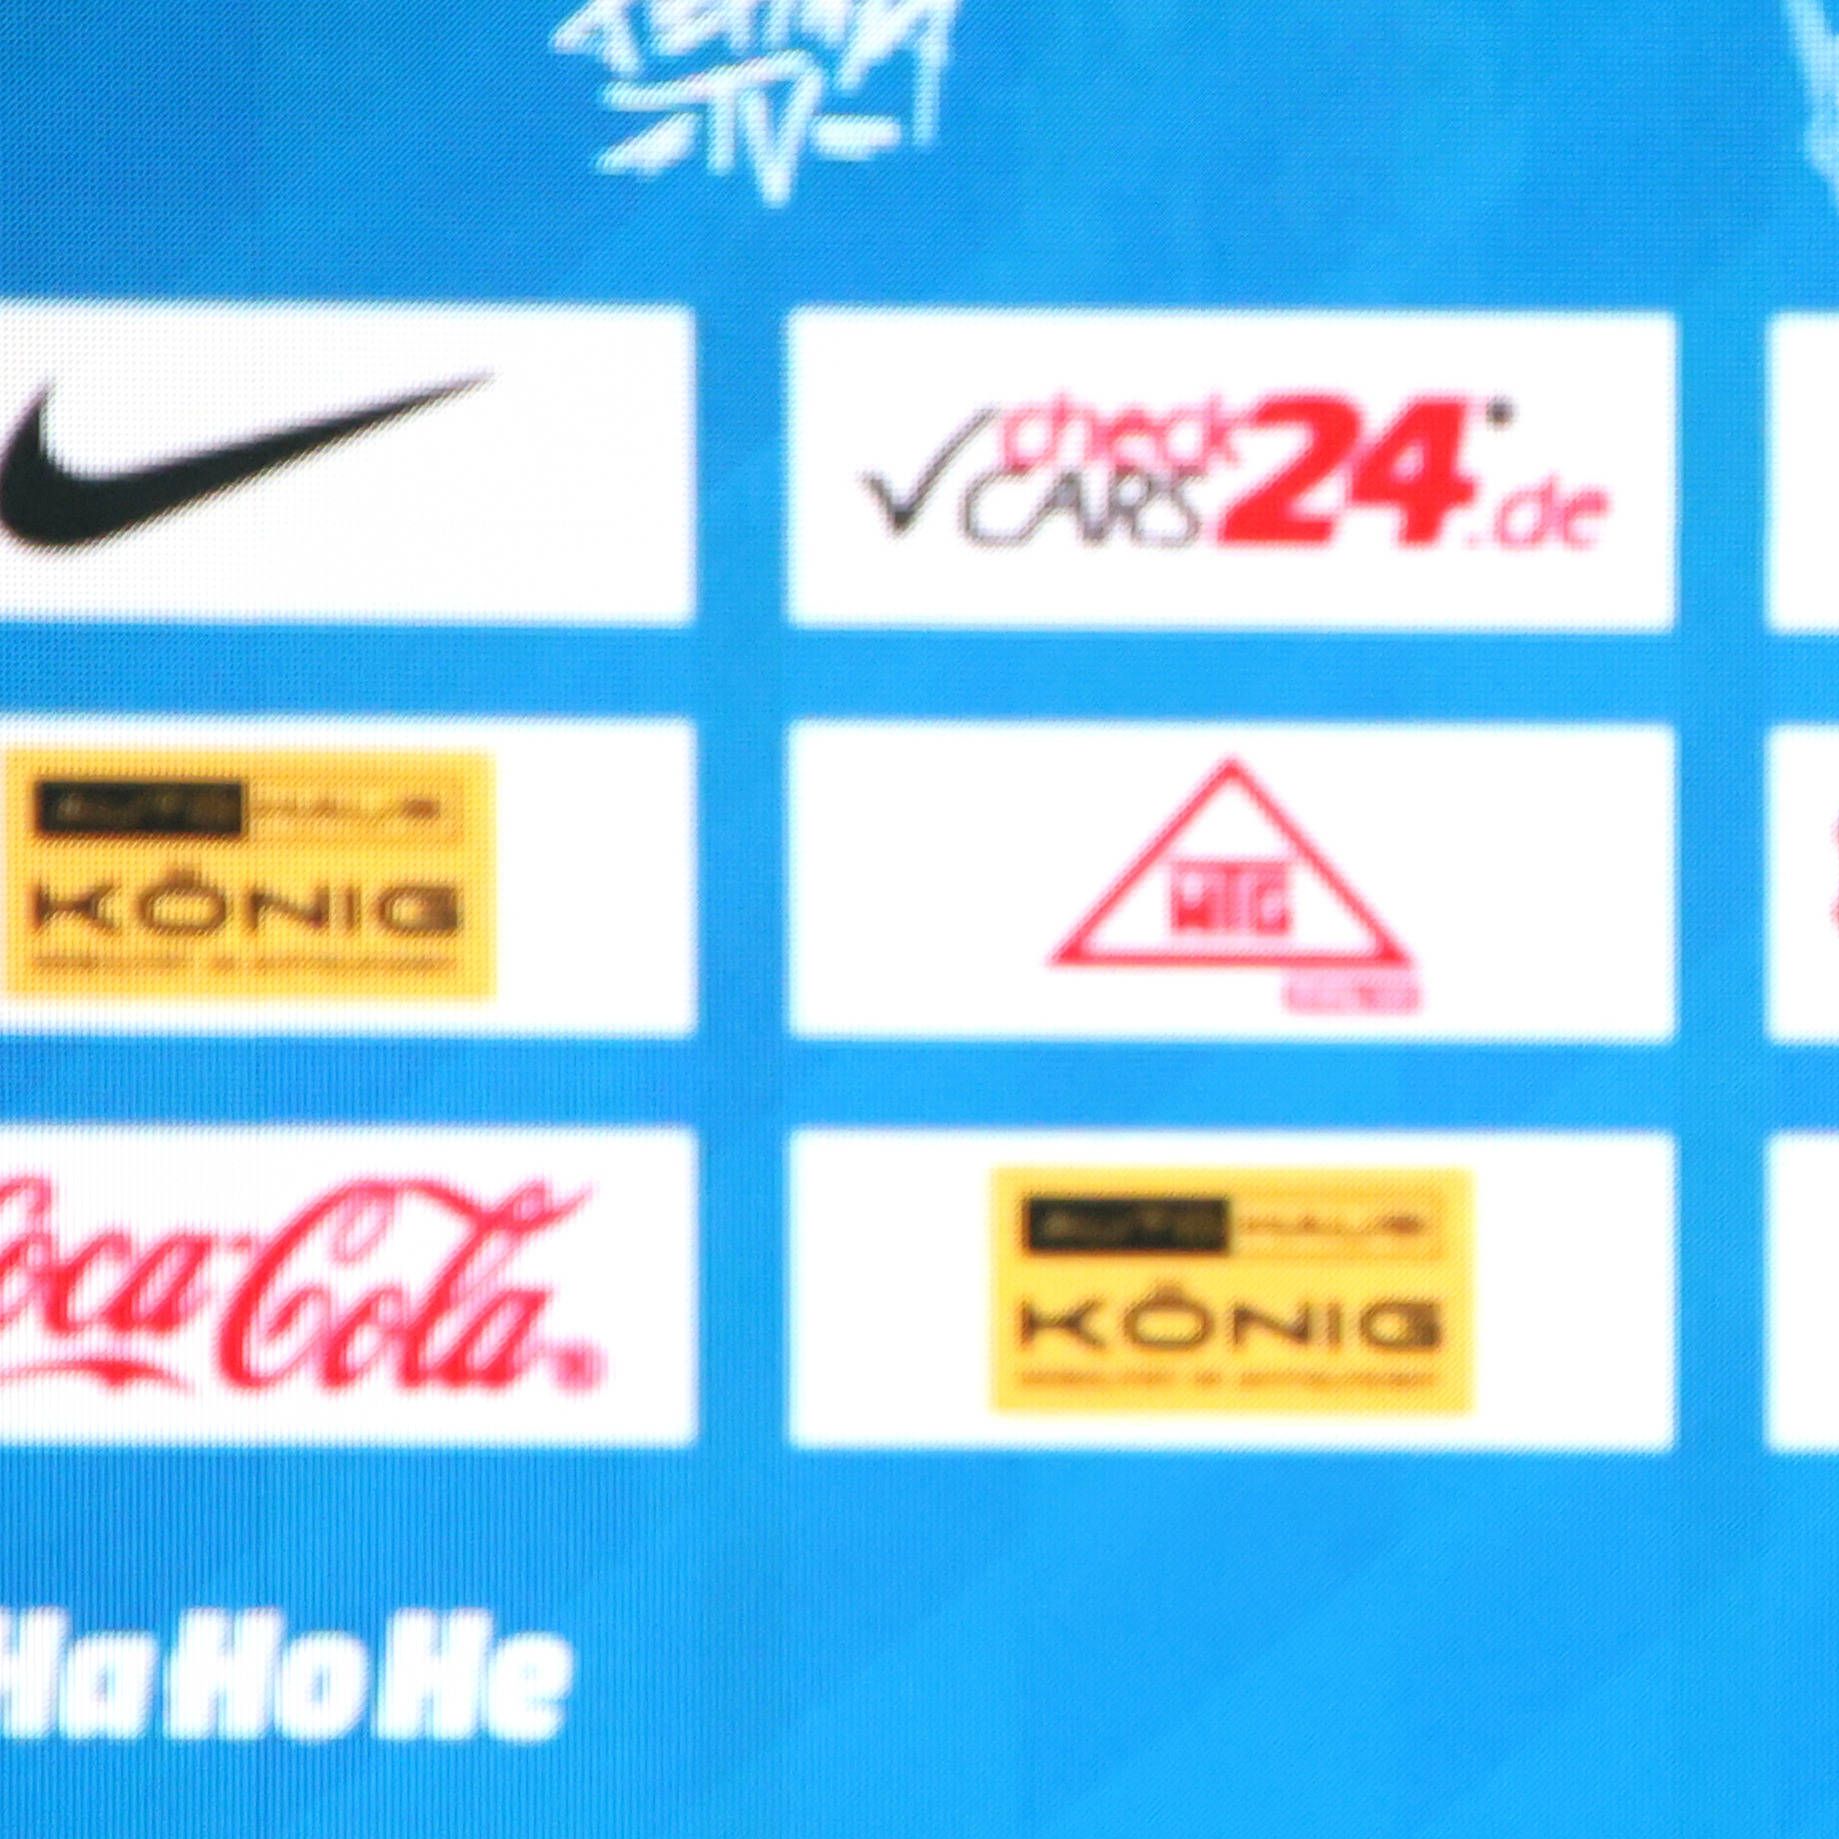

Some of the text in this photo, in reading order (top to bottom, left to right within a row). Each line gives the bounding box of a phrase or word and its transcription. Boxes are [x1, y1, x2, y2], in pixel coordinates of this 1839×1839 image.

[32, 862, 464, 938] KÖNIG
[0, 1176, 592, 1394] oca-Cola
[1016, 1278, 1446, 1352] KÖNIG
